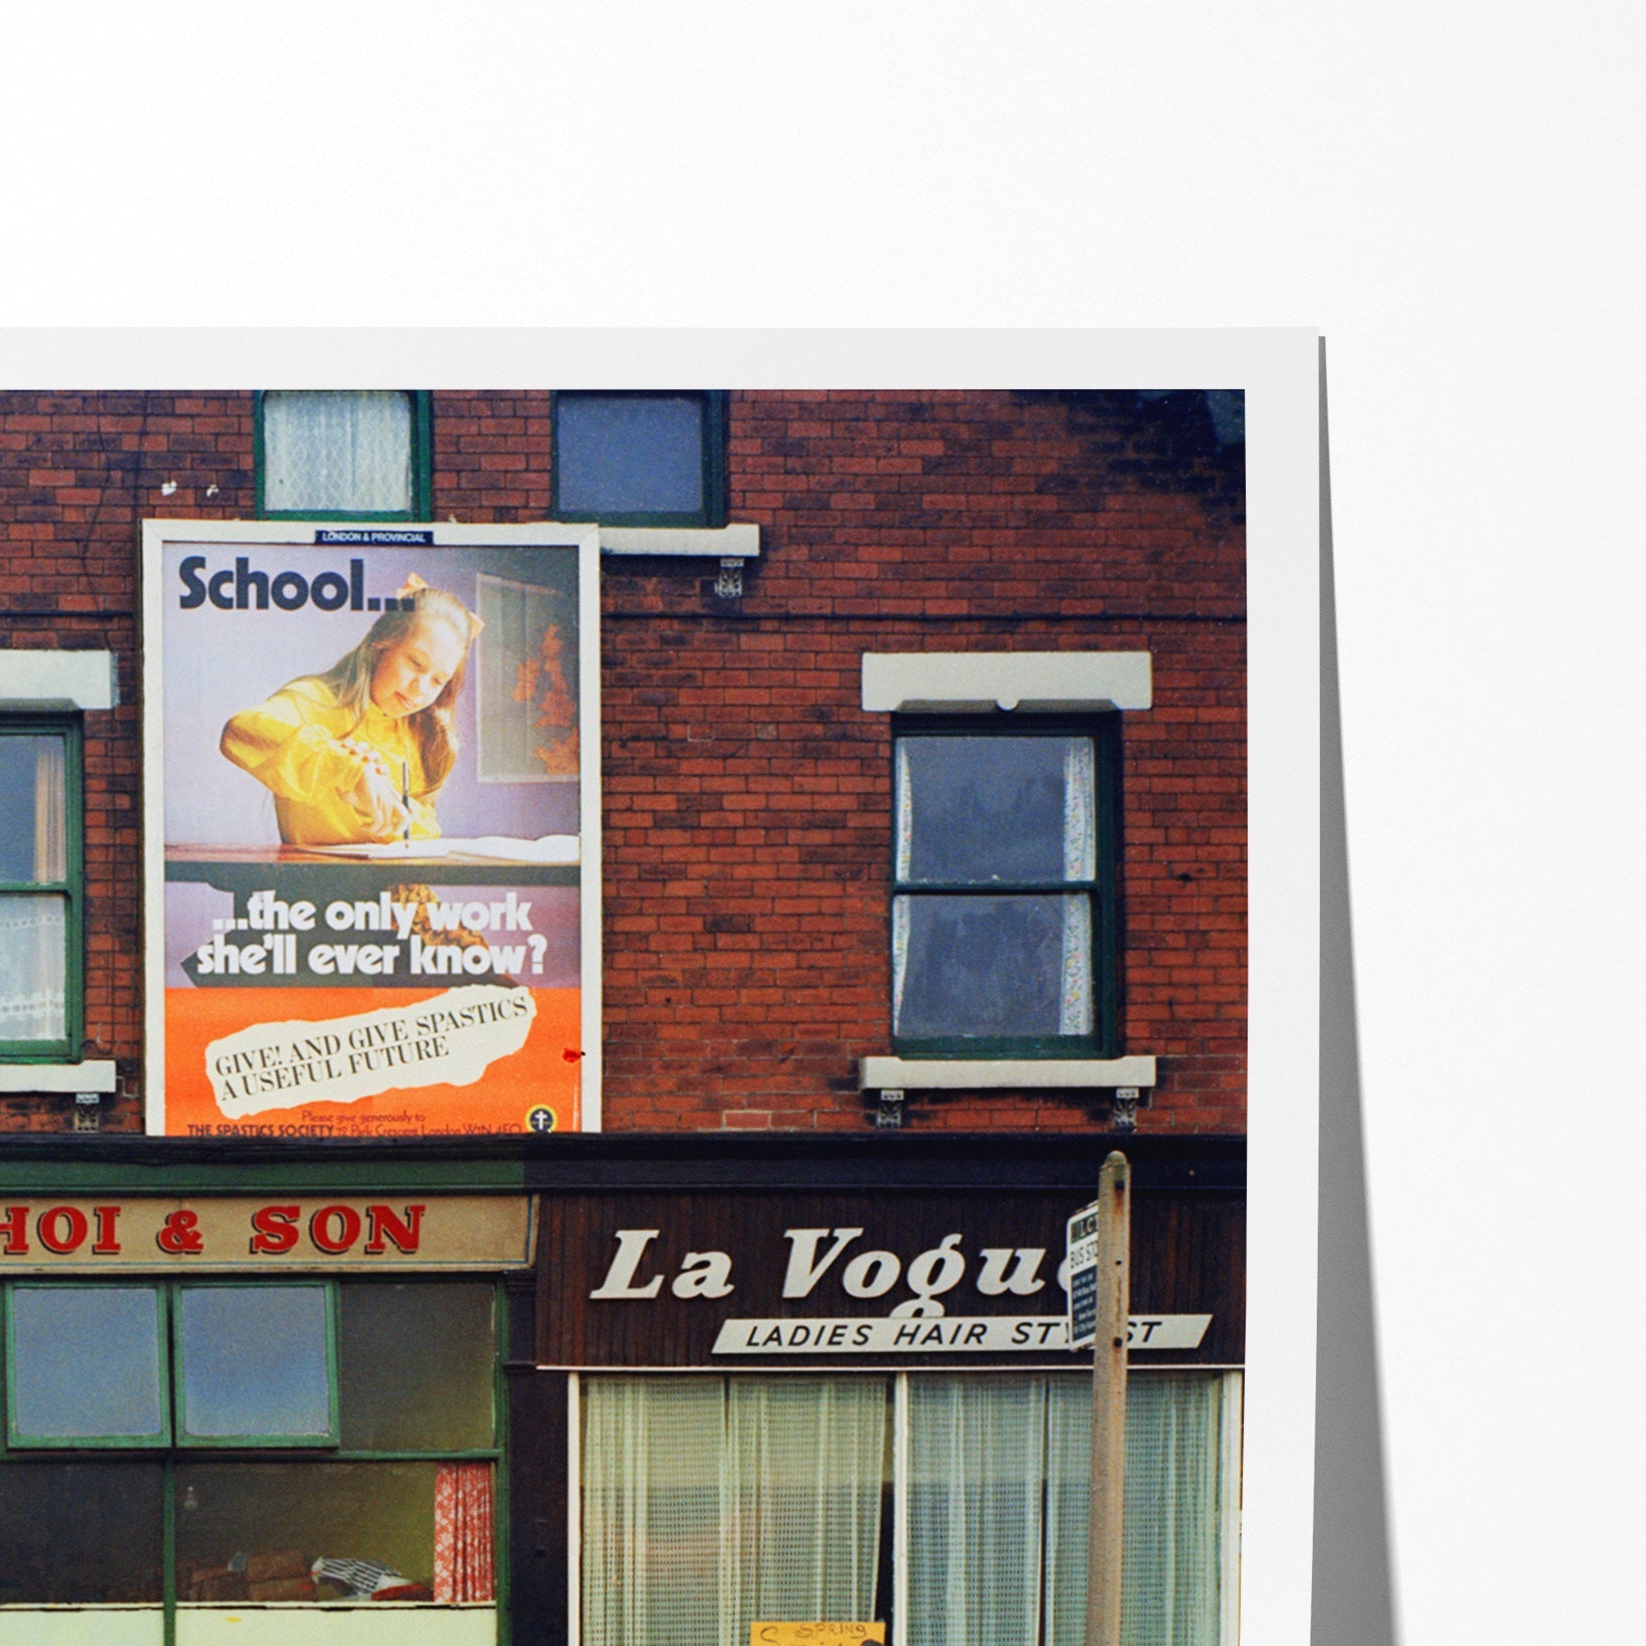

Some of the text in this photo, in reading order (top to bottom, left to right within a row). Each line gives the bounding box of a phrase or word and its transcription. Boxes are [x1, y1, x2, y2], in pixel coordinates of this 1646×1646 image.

[322, 532, 426, 543] LONDON & PROVINCIAL
[179, 556, 415, 611] School...
[213, 889, 533, 939] ...the only work
[197, 933, 548, 974] she'll ever know?
[215, 996, 529, 1078] GIVE! AND GIVE SPASTICS
[221, 1034, 450, 1101] A USEFUL FUTURE
[188, 1125, 211, 1136] THE
[216, 1125, 273, 1136] SPASTICS
[278, 1125, 334, 1136] SOCIETY
[302, 1110, 426, 1125] Please give generously to
[157, 1210, 204, 1255] &
[250, 1204, 426, 1255] SON
[590, 1229, 735, 1299] La
[782, 1228, 1068, 1318] Vogu
[746, 1324, 873, 1347] LADIES
[893, 1323, 989, 1345] HAIR
